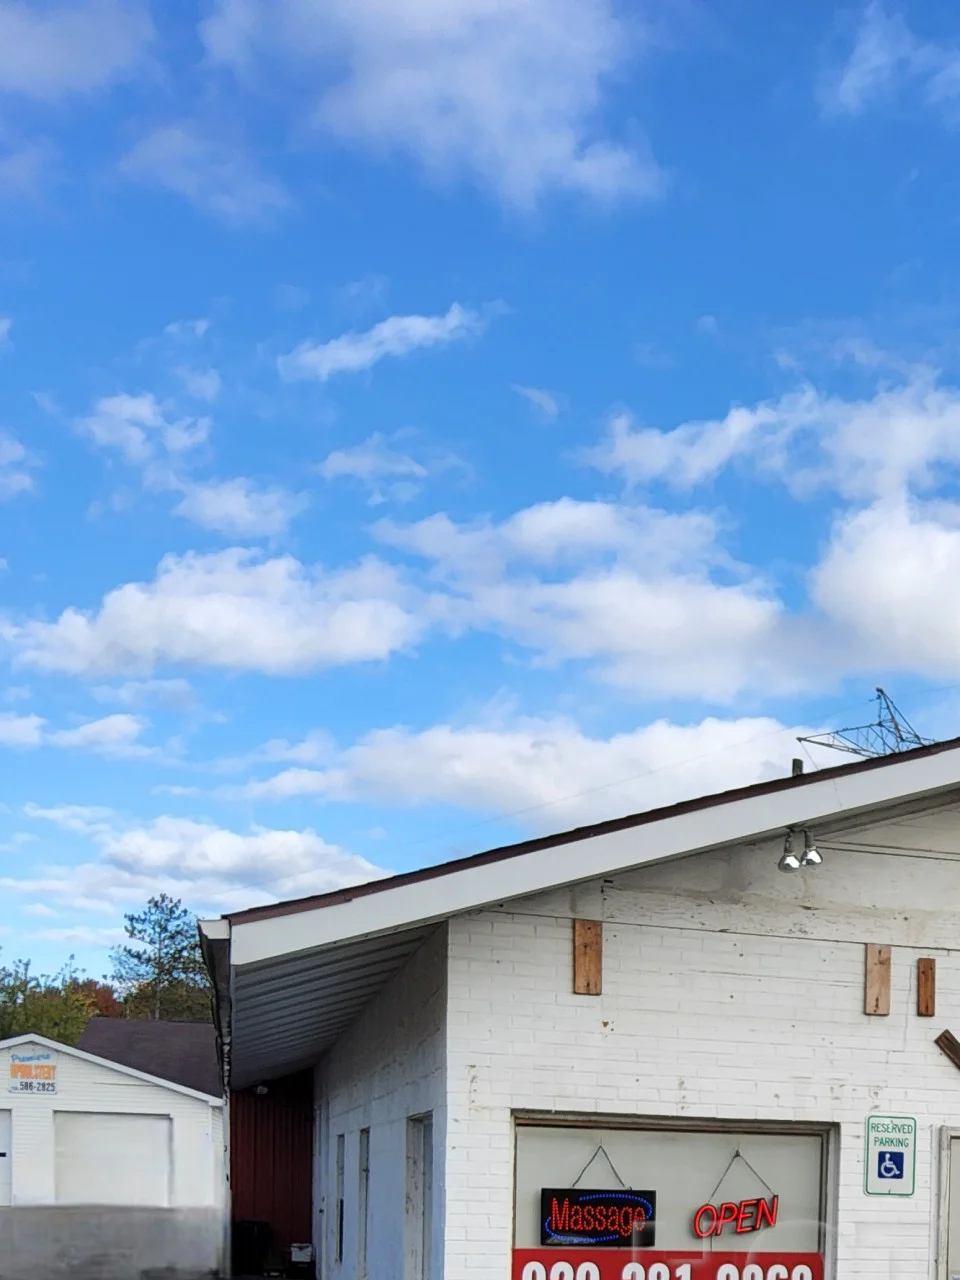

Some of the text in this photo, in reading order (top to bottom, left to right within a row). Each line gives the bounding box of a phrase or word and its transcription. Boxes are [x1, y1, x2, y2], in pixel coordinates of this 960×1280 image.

[870, 1122, 913, 1135] RESERVED
[873, 1136, 910, 1149] PARKING
[550, 1197, 647, 1237] Massage
[693, 1195, 779, 1239] OPEN
